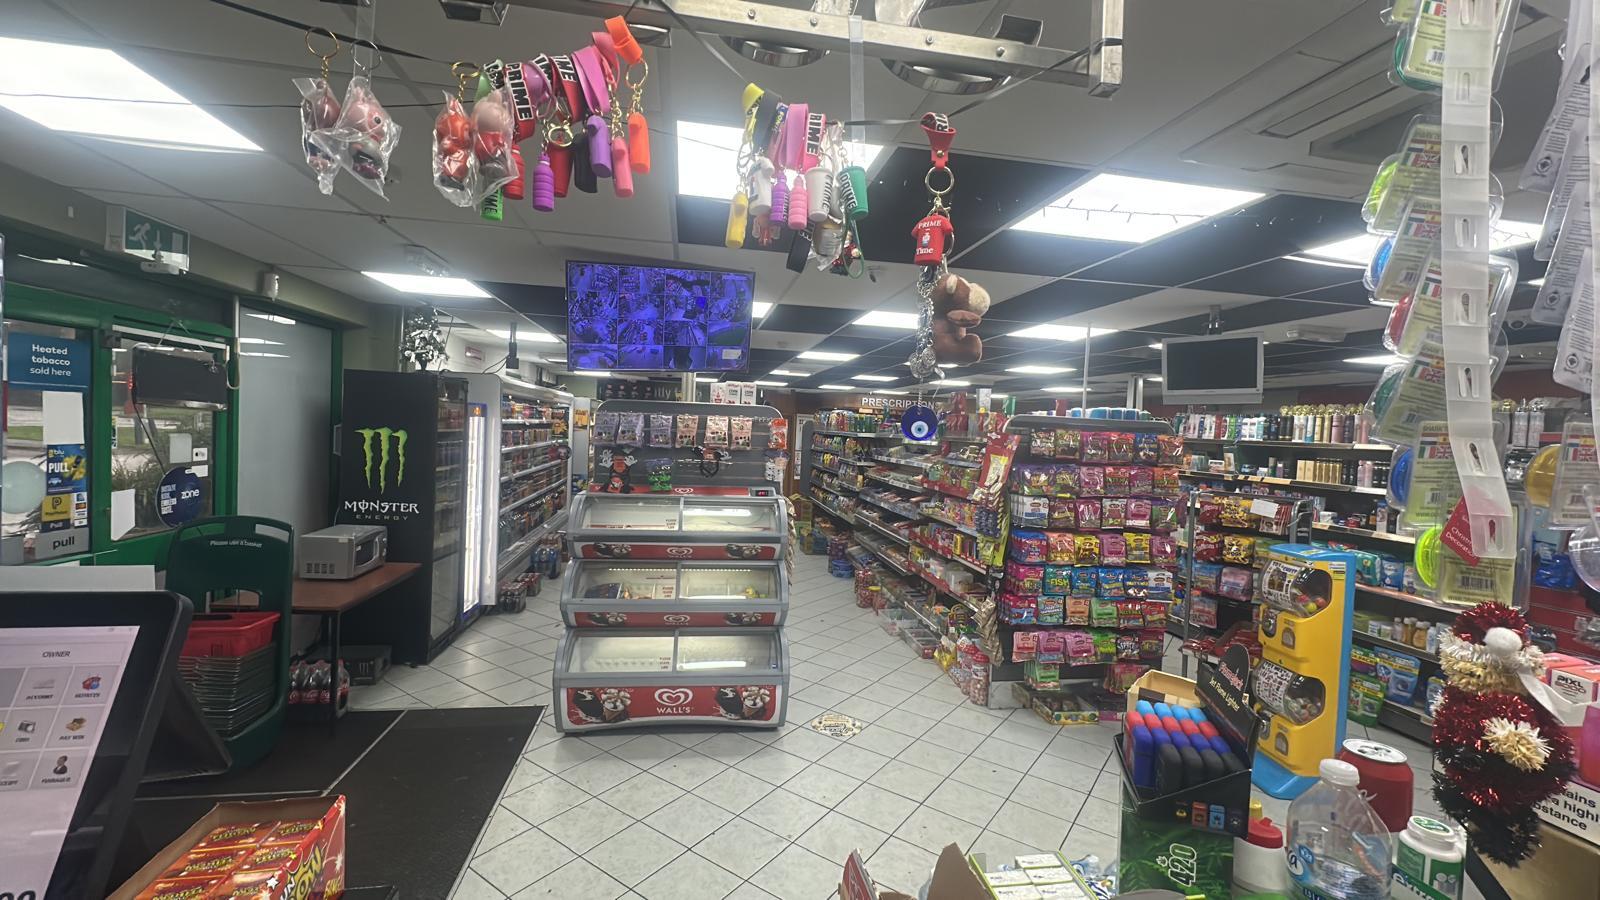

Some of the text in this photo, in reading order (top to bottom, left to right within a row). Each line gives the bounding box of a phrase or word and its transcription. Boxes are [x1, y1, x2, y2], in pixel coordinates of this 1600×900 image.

[505, 62, 534, 121] PRIME
[917, 219, 943, 230] PRIME
[32, 343, 68, 355] Heated
[32, 355, 71, 366] tobacco
[30, 366, 72, 377] sold here
[48, 462, 70, 474] PULL
[181, 488, 200, 500] zone
[344, 499, 420, 515] MONSTER
[52, 535, 75, 551] pull
[42, 650, 71, 658] OWNER
[1556, 674, 1584, 689] PIXL
[656, 706, 691, 714] WALL'S
[1167, 842, 1198, 888] 420
